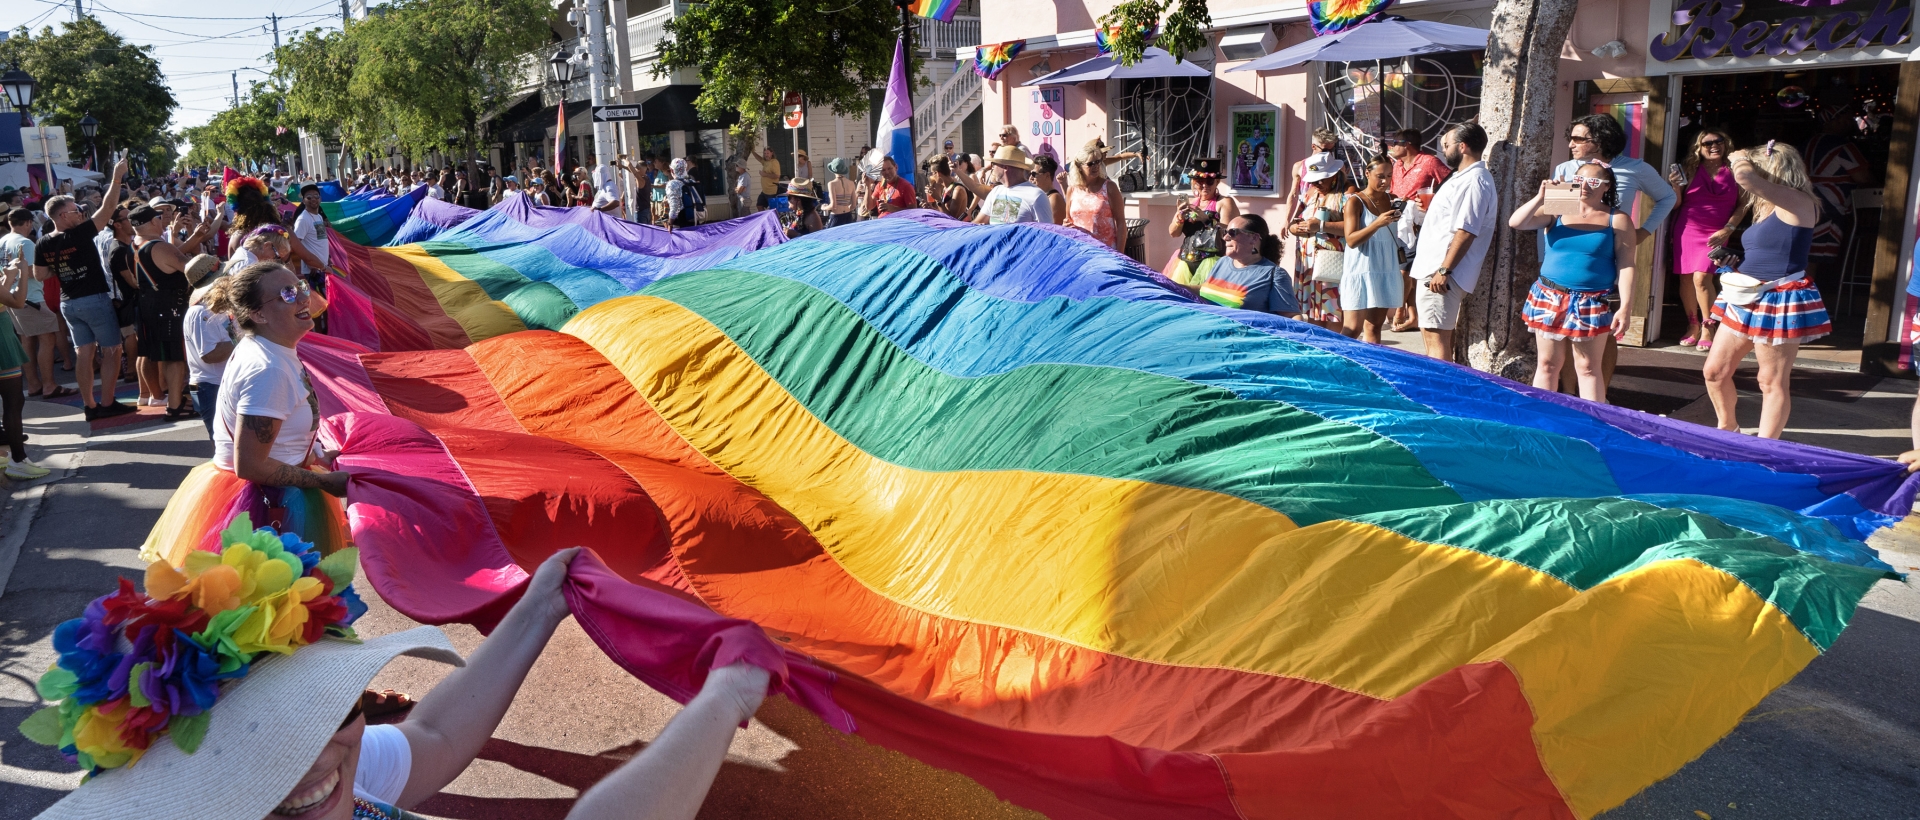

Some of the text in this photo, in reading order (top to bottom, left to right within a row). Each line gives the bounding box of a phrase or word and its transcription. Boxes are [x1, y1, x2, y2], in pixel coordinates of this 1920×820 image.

[1650, 0, 1913, 62] Beach
[1032, 89, 1061, 103] THE
[1238, 113, 1267, 126] DRAG
[1032, 119, 1061, 136] 801
